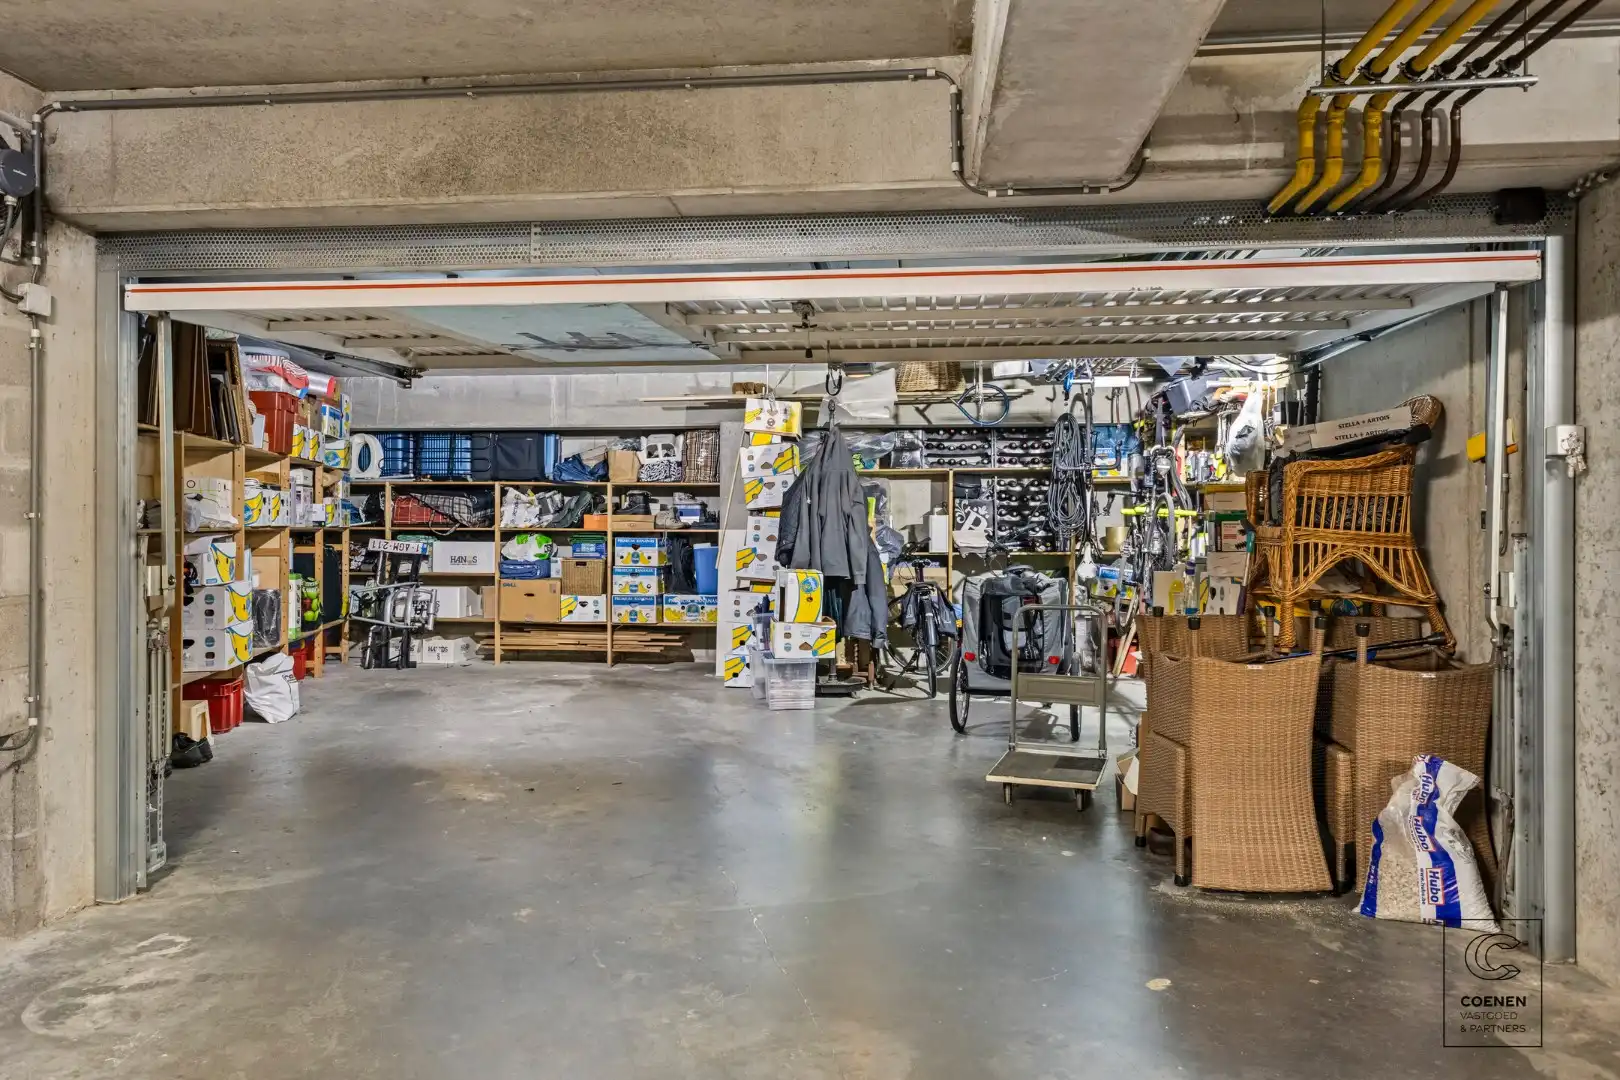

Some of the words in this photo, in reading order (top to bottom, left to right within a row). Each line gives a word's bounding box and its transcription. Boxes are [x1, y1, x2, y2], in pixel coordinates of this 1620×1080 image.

[1338, 420, 1360, 429] STELLA
[1367, 414, 1390, 424] ARTOIS
[1334, 433, 1358, 441] STELLA
[372, 540, 420, 553] 1-AGM-211
[1419, 774, 1433, 805] Hubo
[1413, 818, 1429, 850] Hubo
[1429, 870, 1441, 903] Hubo
